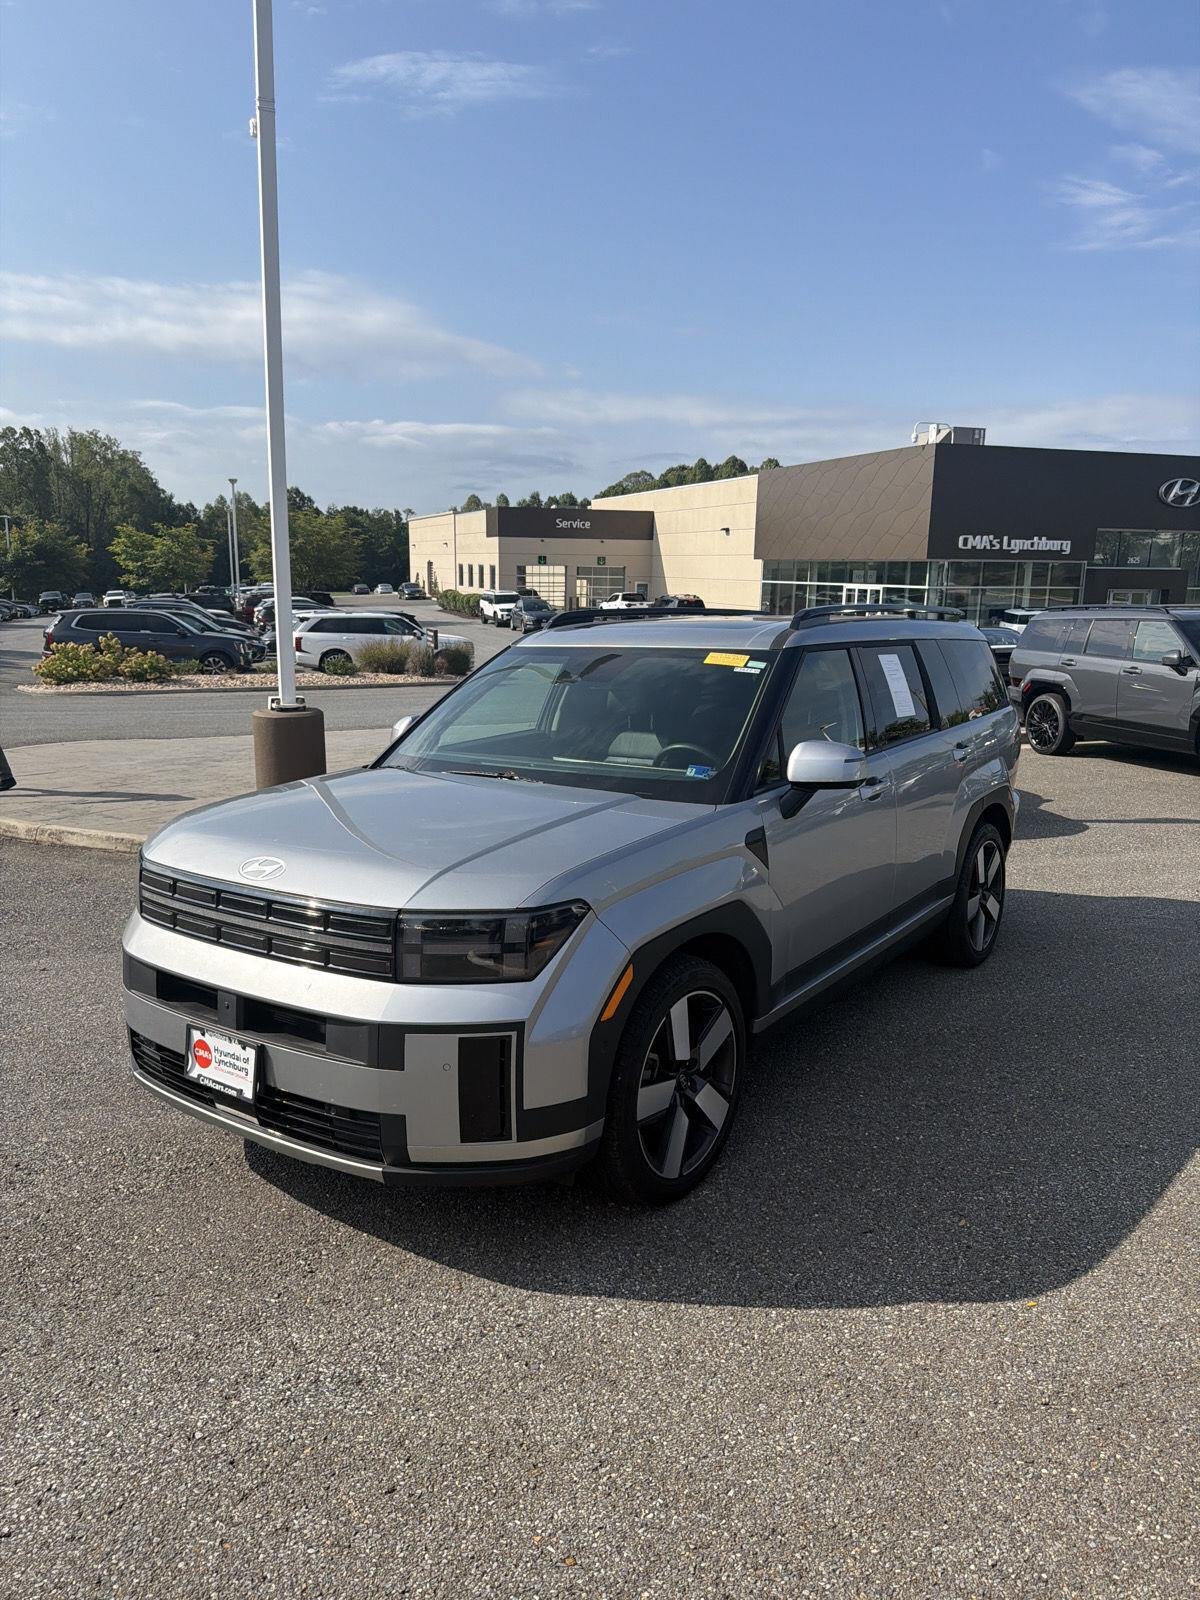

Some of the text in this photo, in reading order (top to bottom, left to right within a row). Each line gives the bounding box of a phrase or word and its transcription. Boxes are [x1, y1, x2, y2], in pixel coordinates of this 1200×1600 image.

[555, 518, 591, 529] Service
[958, 535, 1072, 555] CMA's Lynchburg
[213, 1045, 250, 1065] Hyundai of
[214, 1055, 249, 1077] Lynchburg
[199, 1076, 238, 1097] CMAcars.com
